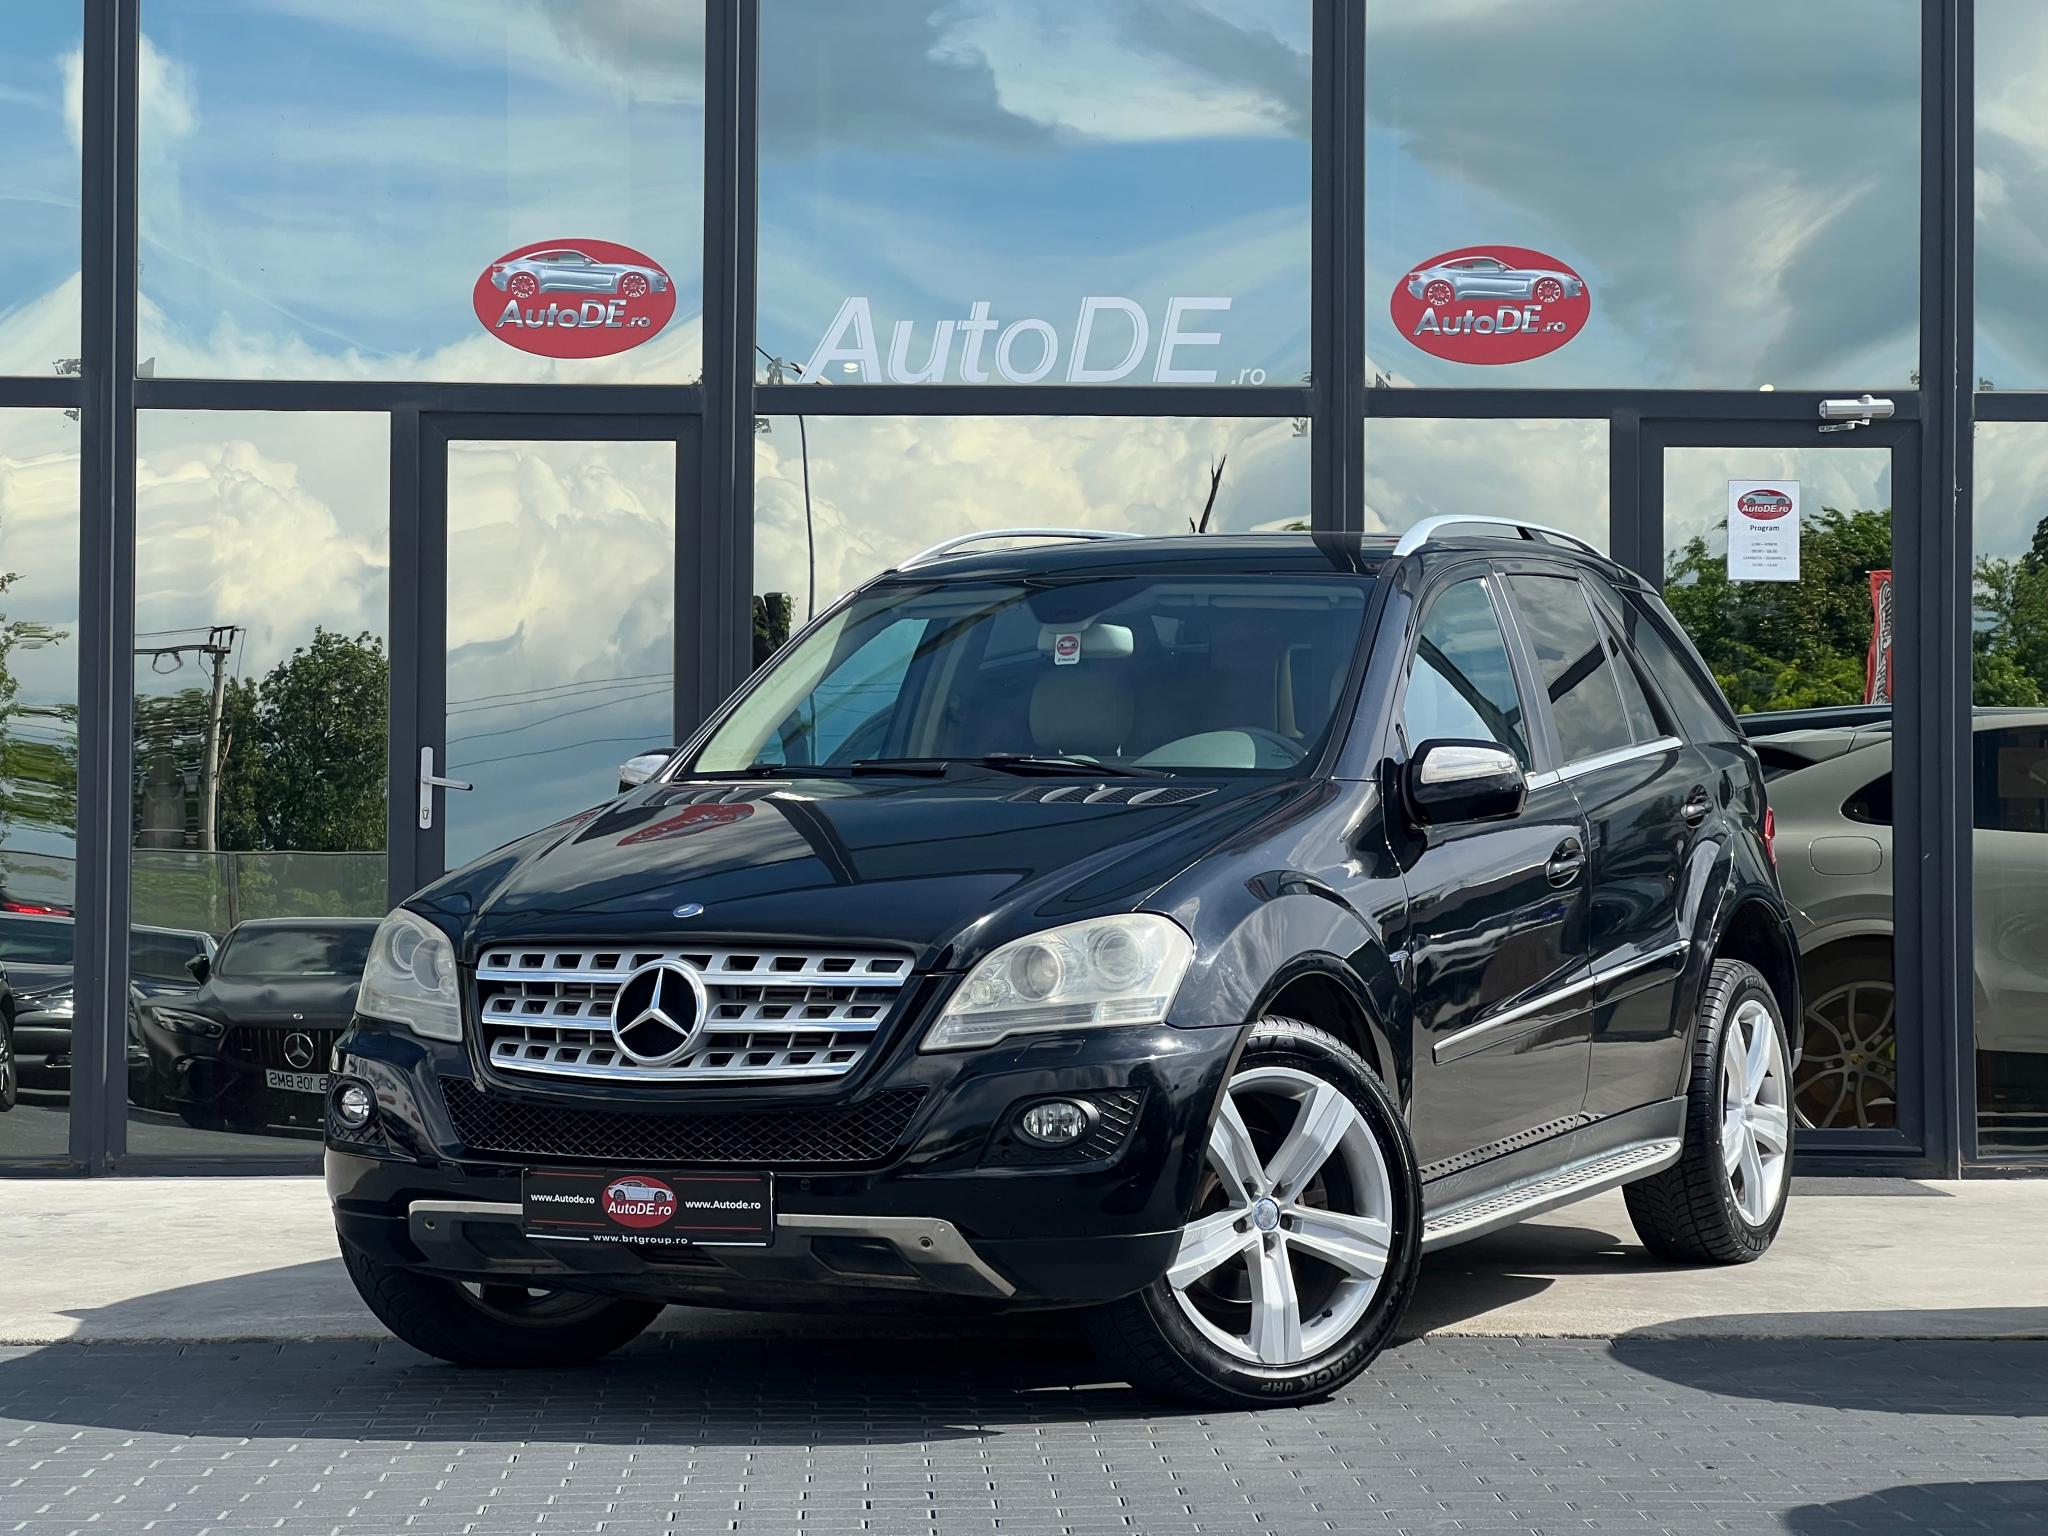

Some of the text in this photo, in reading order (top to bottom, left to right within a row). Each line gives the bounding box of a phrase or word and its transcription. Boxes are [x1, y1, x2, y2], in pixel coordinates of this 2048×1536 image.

[1741, 504, 1789, 513] AutoDE.ro
[530, 1193, 595, 1204] www.Autode.ro
[607, 1202, 672, 1216] AutoDE.ro
[685, 1199, 761, 1210] www.Autode.ro
[593, 1234, 688, 1245] www.brtgroup.ro
[1261, 1381, 1294, 1393] UHP
